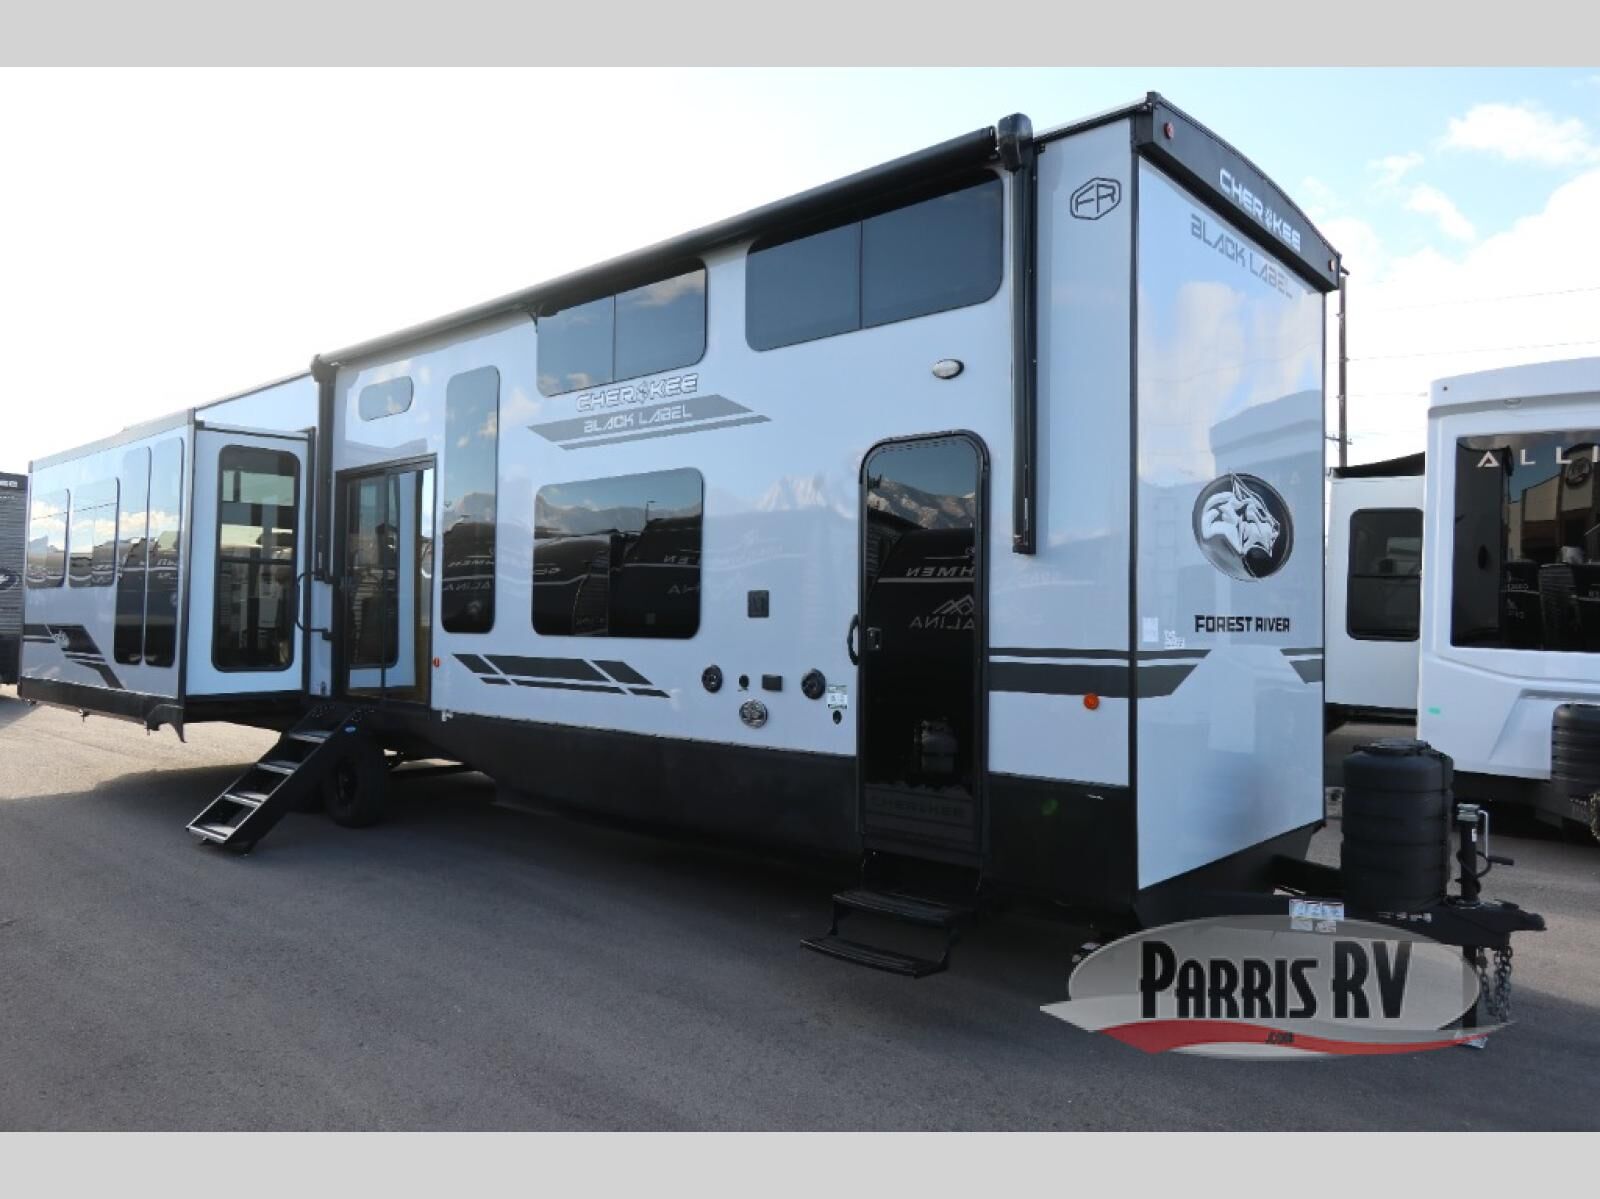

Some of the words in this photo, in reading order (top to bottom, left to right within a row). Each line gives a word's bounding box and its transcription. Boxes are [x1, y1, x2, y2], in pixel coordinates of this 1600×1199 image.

[1190, 213, 1247, 267] BLACK
[1249, 251, 1293, 299] LABEL
[583, 414, 635, 433] BLACK
[639, 404, 693, 425] LABEL
[1194, 614, 1254, 633] FOREST
[1255, 617, 1290, 633] RIVER
